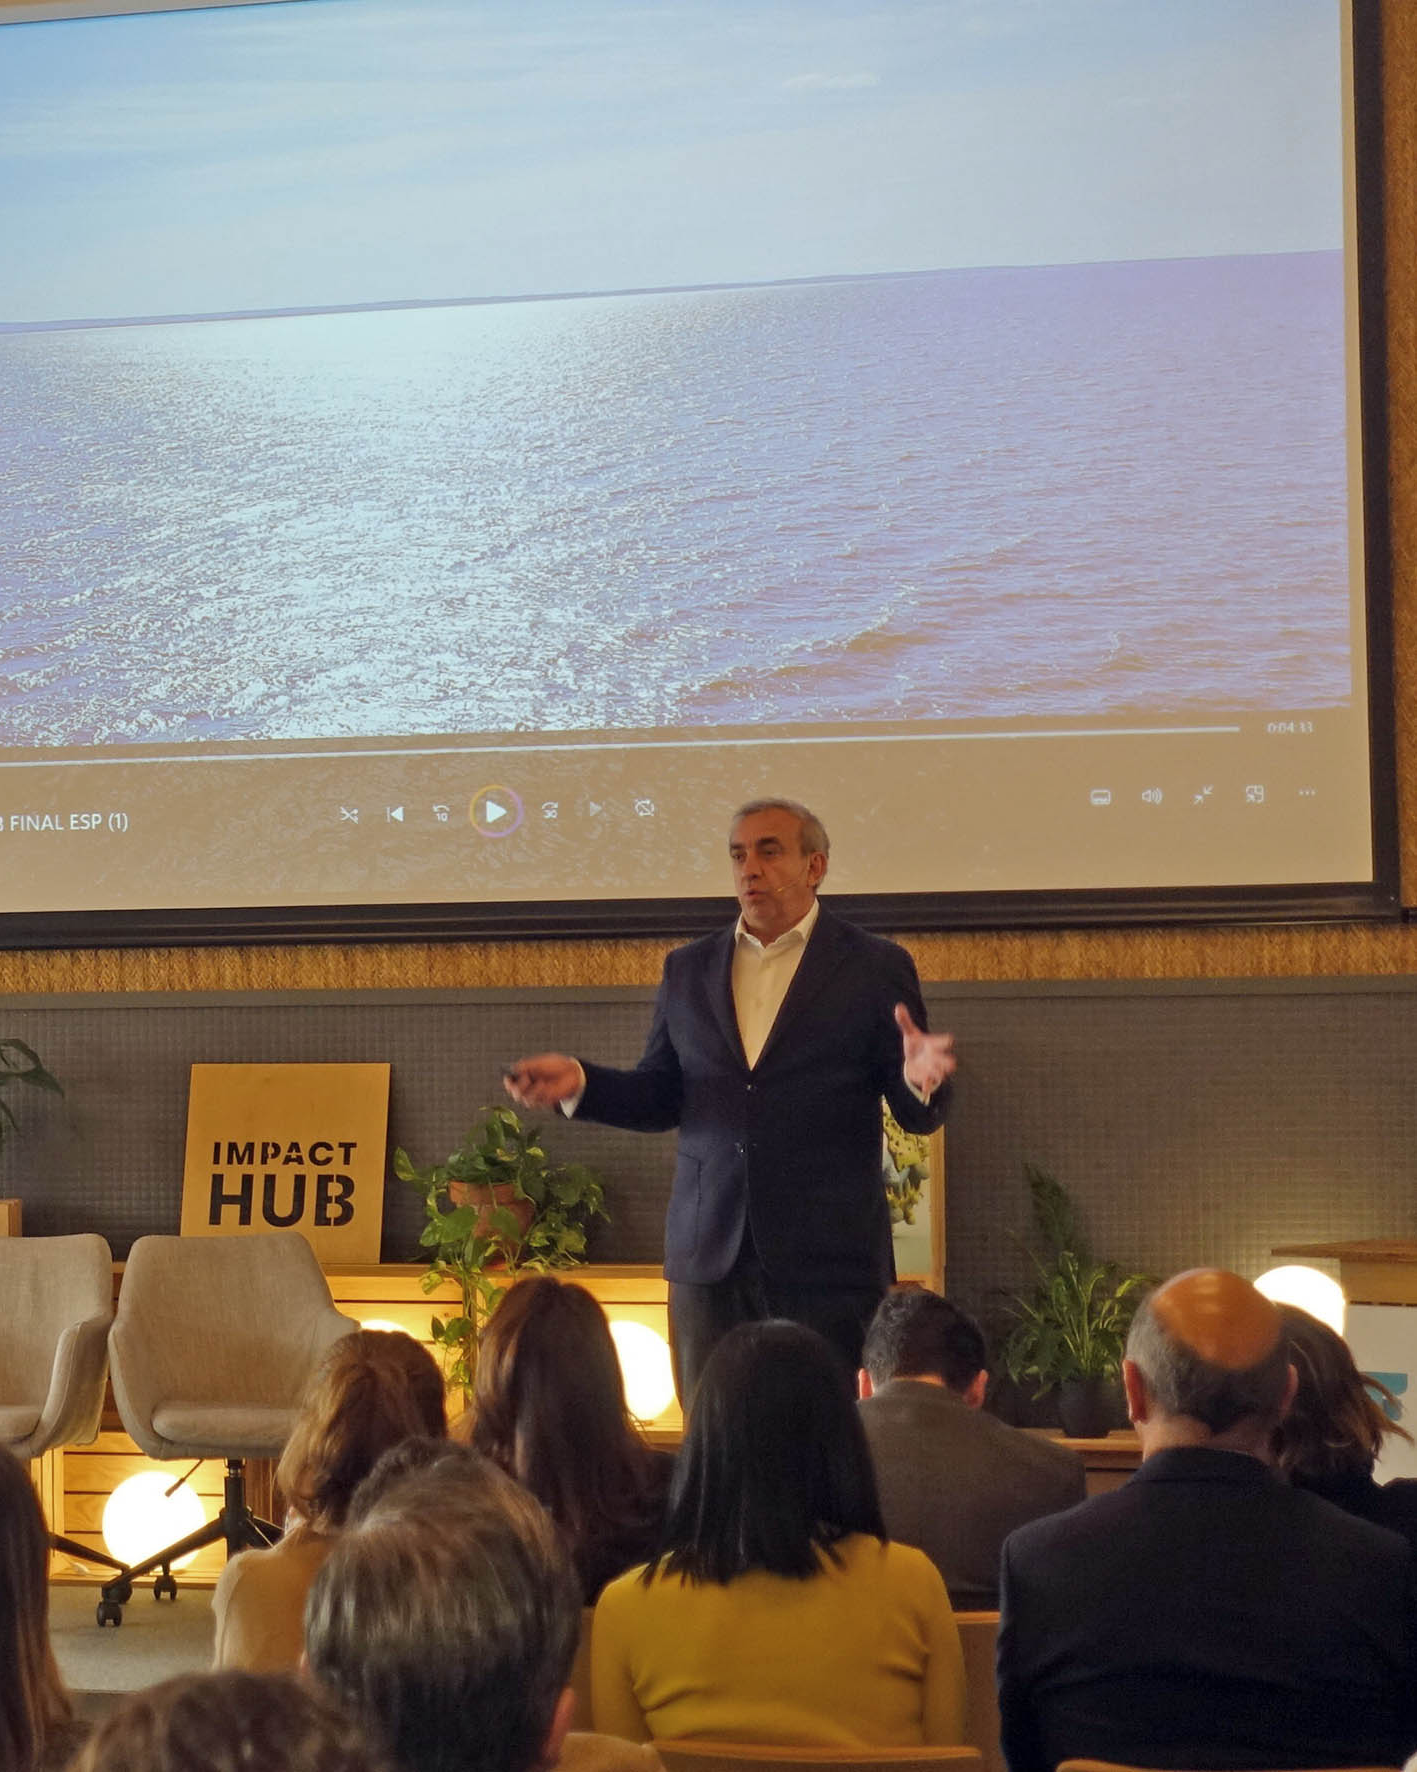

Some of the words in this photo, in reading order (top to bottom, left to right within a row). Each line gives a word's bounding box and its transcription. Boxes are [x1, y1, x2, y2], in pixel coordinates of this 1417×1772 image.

[9, 814, 64, 832] FINAL
[69, 813, 103, 831] ESP
[108, 812, 129, 832] (1)
[436, 812, 449, 822] 10
[212, 1141, 358, 1167] IMPACT
[208, 1173, 356, 1228] HUB
